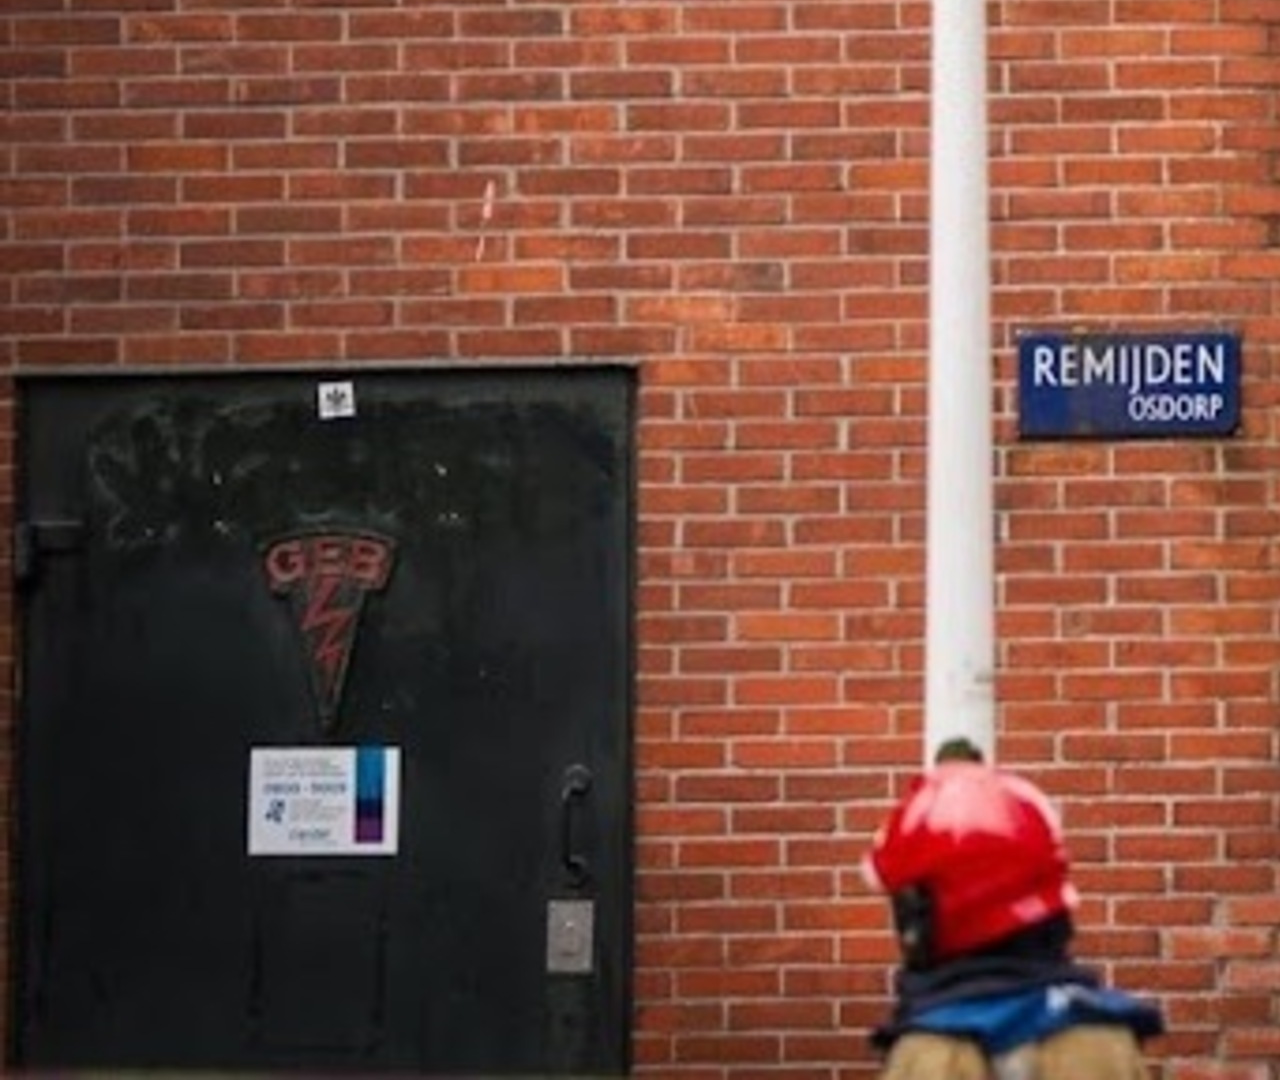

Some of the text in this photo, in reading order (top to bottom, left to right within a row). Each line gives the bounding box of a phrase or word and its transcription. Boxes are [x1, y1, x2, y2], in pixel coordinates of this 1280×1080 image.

[1033, 344, 1225, 394] REMIJDEN
[1128, 394, 1224, 421] OSDORP
[265, 537, 389, 582] GEB
